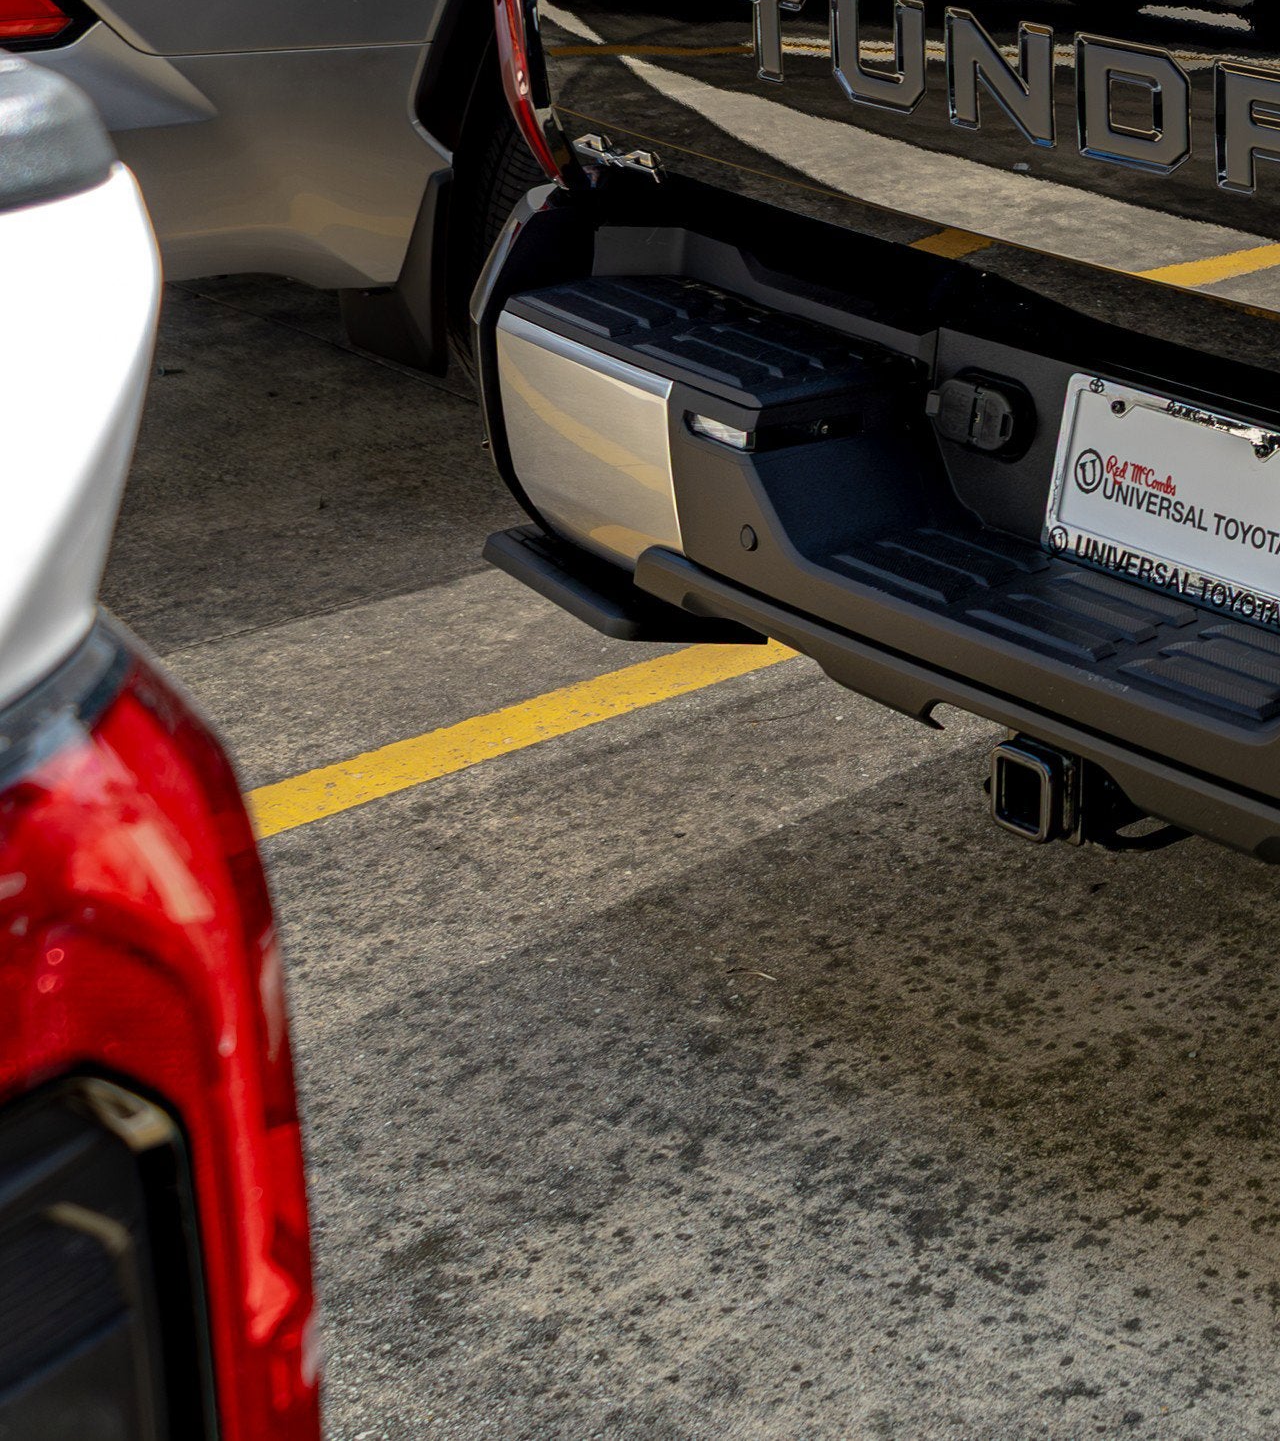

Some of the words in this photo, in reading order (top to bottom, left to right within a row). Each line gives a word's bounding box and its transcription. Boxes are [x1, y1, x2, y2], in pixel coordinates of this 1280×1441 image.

[1106, 455, 1128, 483] Red
[1130, 462, 1177, 497] McCombs
[1102, 477, 1208, 532] UNIVERSAL
[1075, 534, 1196, 597] UNIVERSAL
